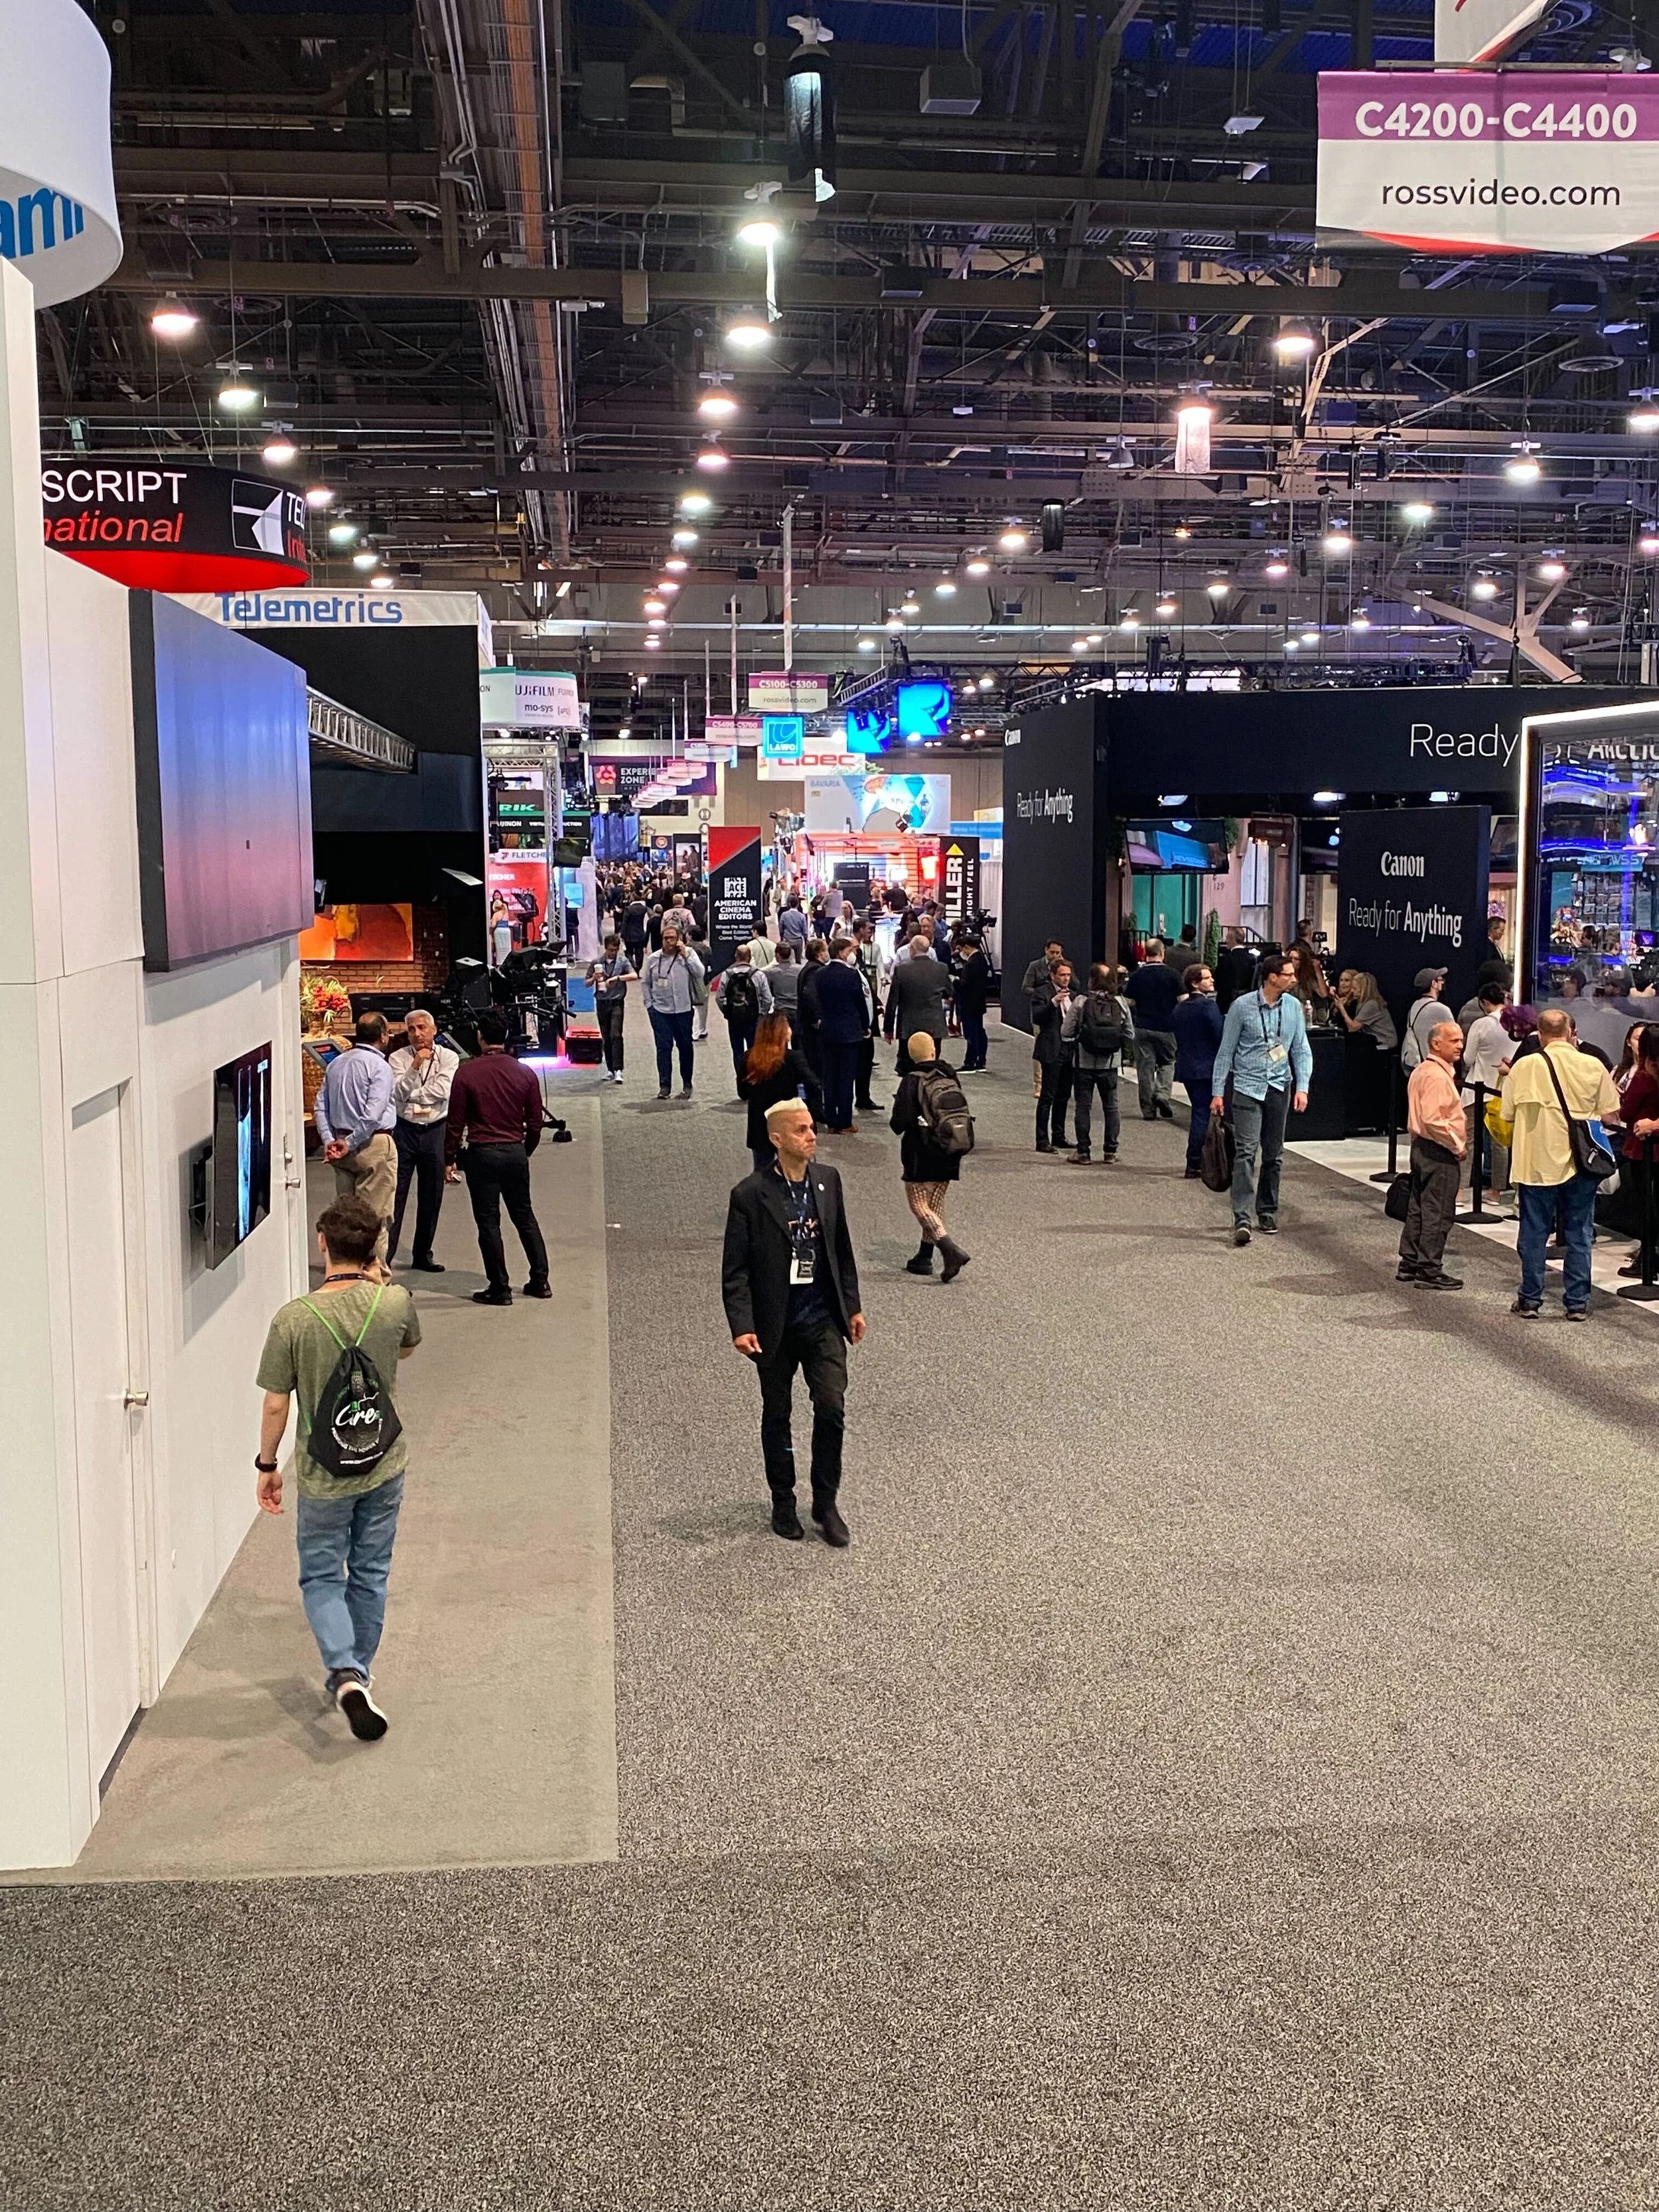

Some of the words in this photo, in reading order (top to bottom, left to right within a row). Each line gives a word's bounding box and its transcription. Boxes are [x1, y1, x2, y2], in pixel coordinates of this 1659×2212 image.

[1355, 100, 1638, 138] C4200-C4400
[1382, 179, 1621, 206] rossvideo.com
[42, 469, 187, 504] SCRIPT
[214, 591, 403, 623] Telemetrics
[515, 684, 554, 696] UJIFILM
[758, 680, 818, 688] C5100-C5300
[1409, 723, 1518, 767] Ready
[1017, 791, 1033, 825] Ready
[1044, 787, 1073, 824] Anything
[1380, 851, 1425, 877] Canon
[1349, 898, 1382, 937] Ready
[1384, 900, 1402, 930] for
[1404, 901, 1462, 948] Anything
